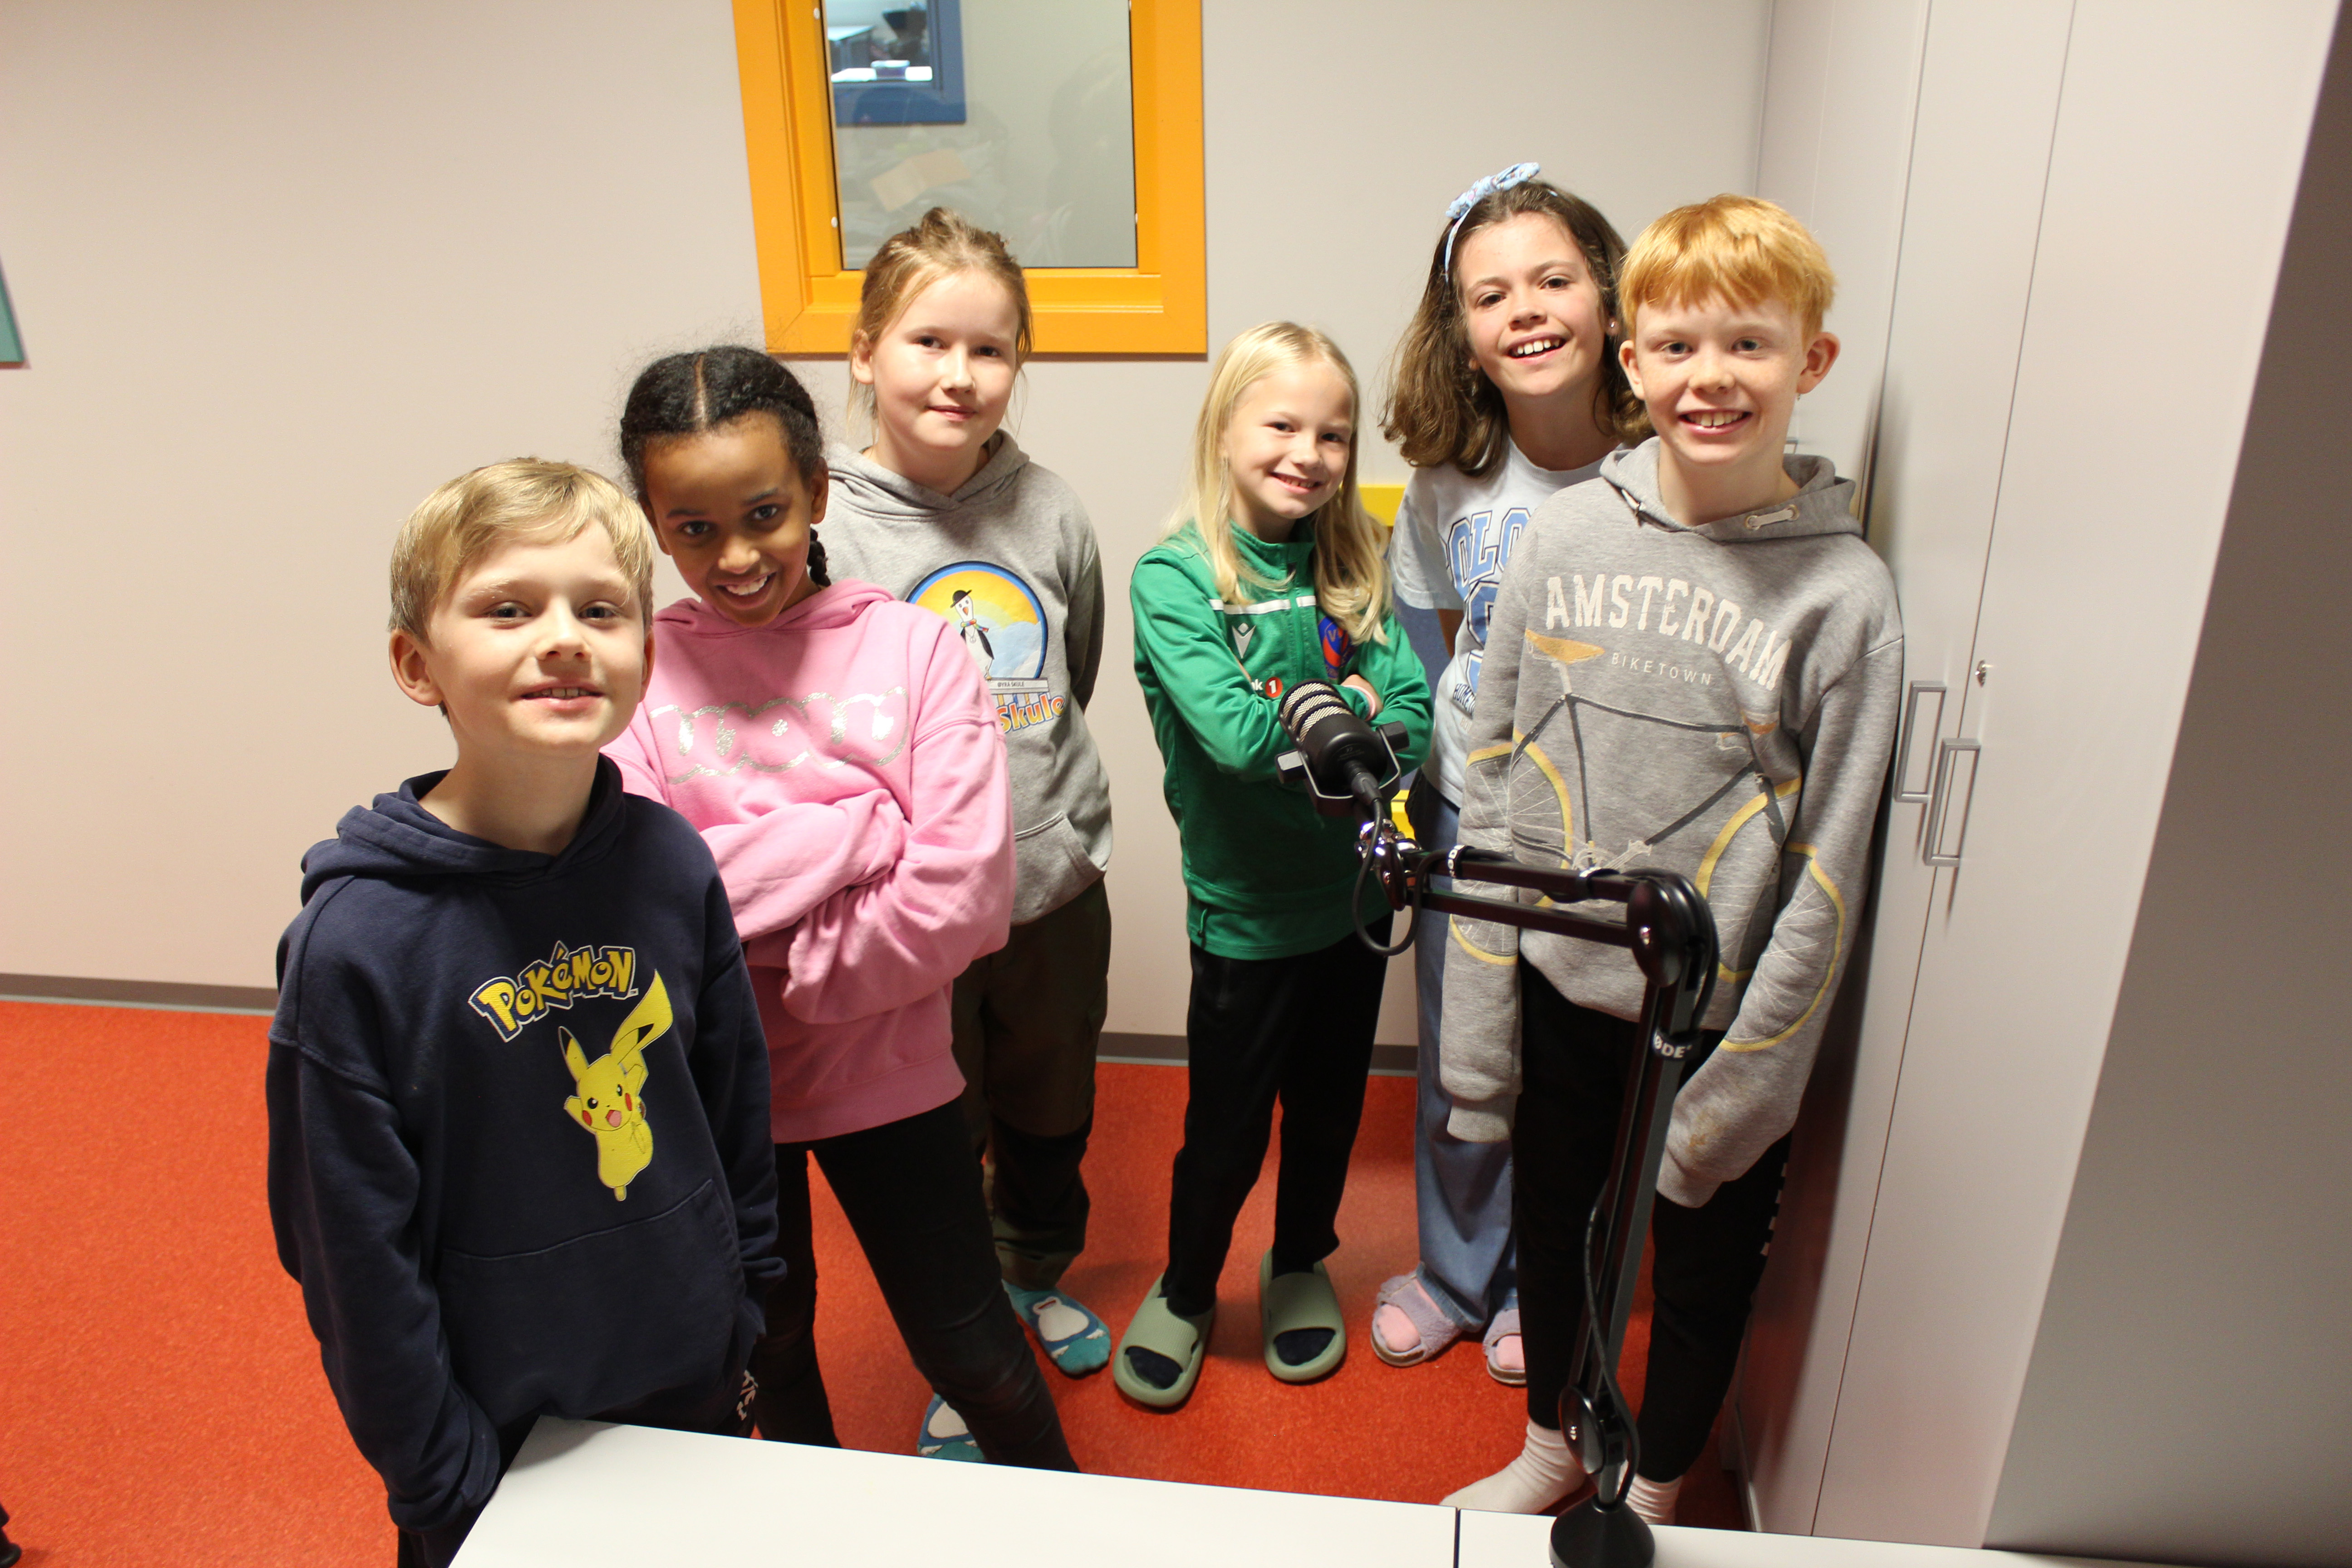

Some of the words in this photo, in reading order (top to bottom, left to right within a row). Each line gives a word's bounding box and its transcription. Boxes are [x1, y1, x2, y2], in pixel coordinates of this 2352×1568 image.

[1546, 573, 1792, 691] AMSTERDAM
[1612, 652, 1712, 686] BIKETOWN
[996, 693, 1065, 734] Skule
